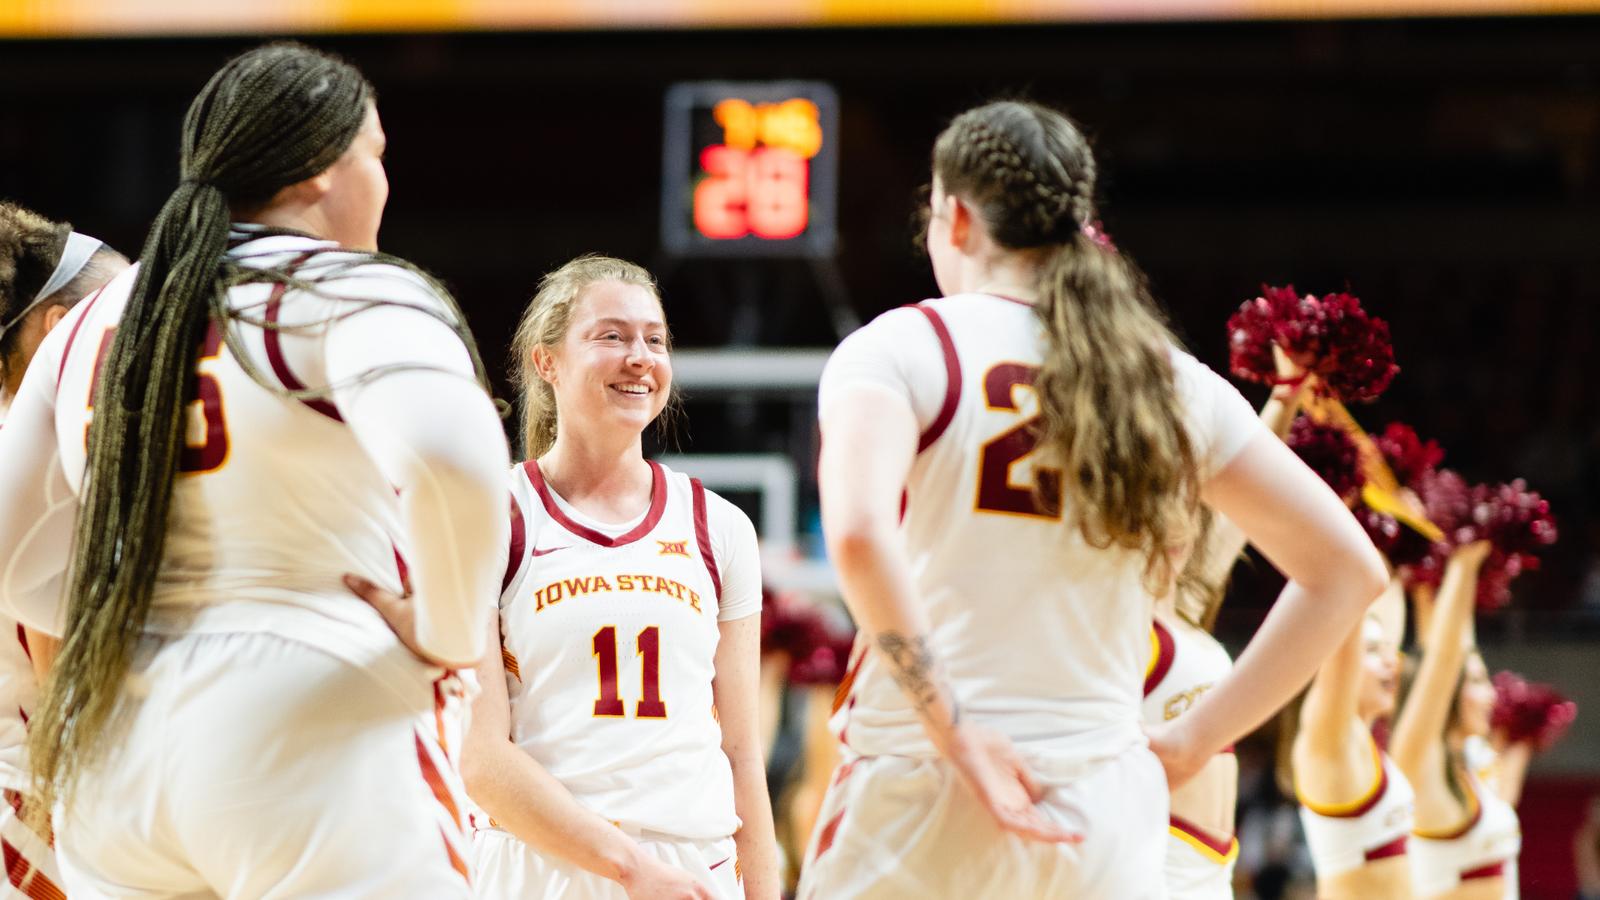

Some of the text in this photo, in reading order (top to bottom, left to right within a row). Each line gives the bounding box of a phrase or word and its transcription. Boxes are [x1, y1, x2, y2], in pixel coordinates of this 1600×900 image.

[534, 574, 702, 614] IOWA STATE
[591, 624, 668, 719] 11
